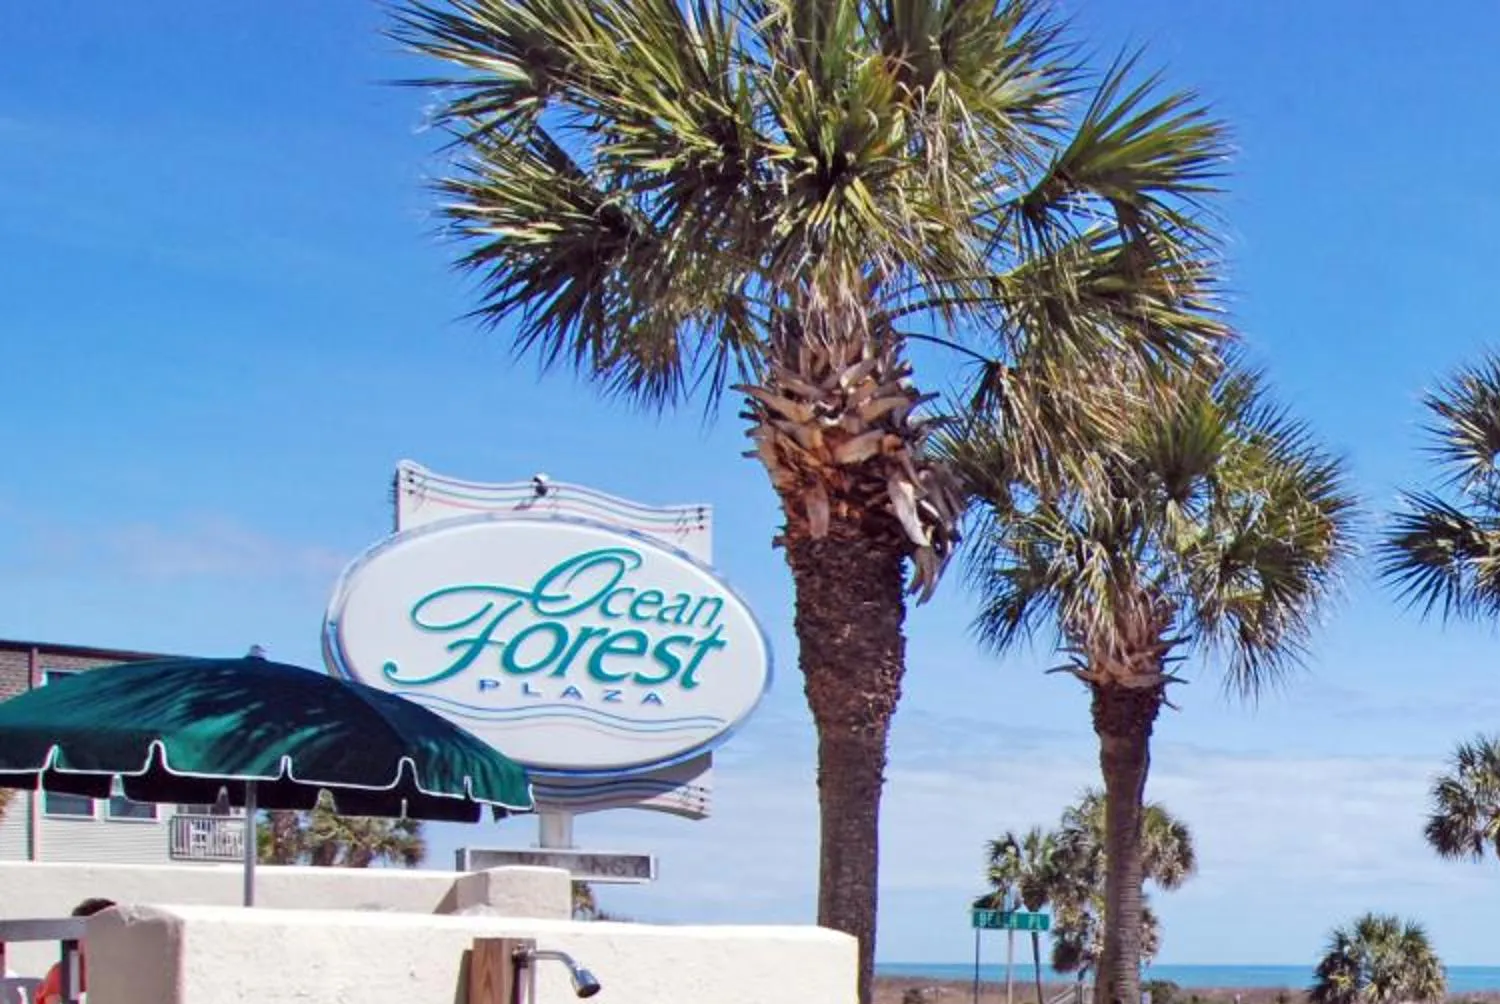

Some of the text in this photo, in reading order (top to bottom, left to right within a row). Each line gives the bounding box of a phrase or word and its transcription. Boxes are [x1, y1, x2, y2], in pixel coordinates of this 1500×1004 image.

[532, 548, 724, 627] Ocean
[383, 584, 727, 690] Forest
[478, 679, 665, 706] PLAZA
